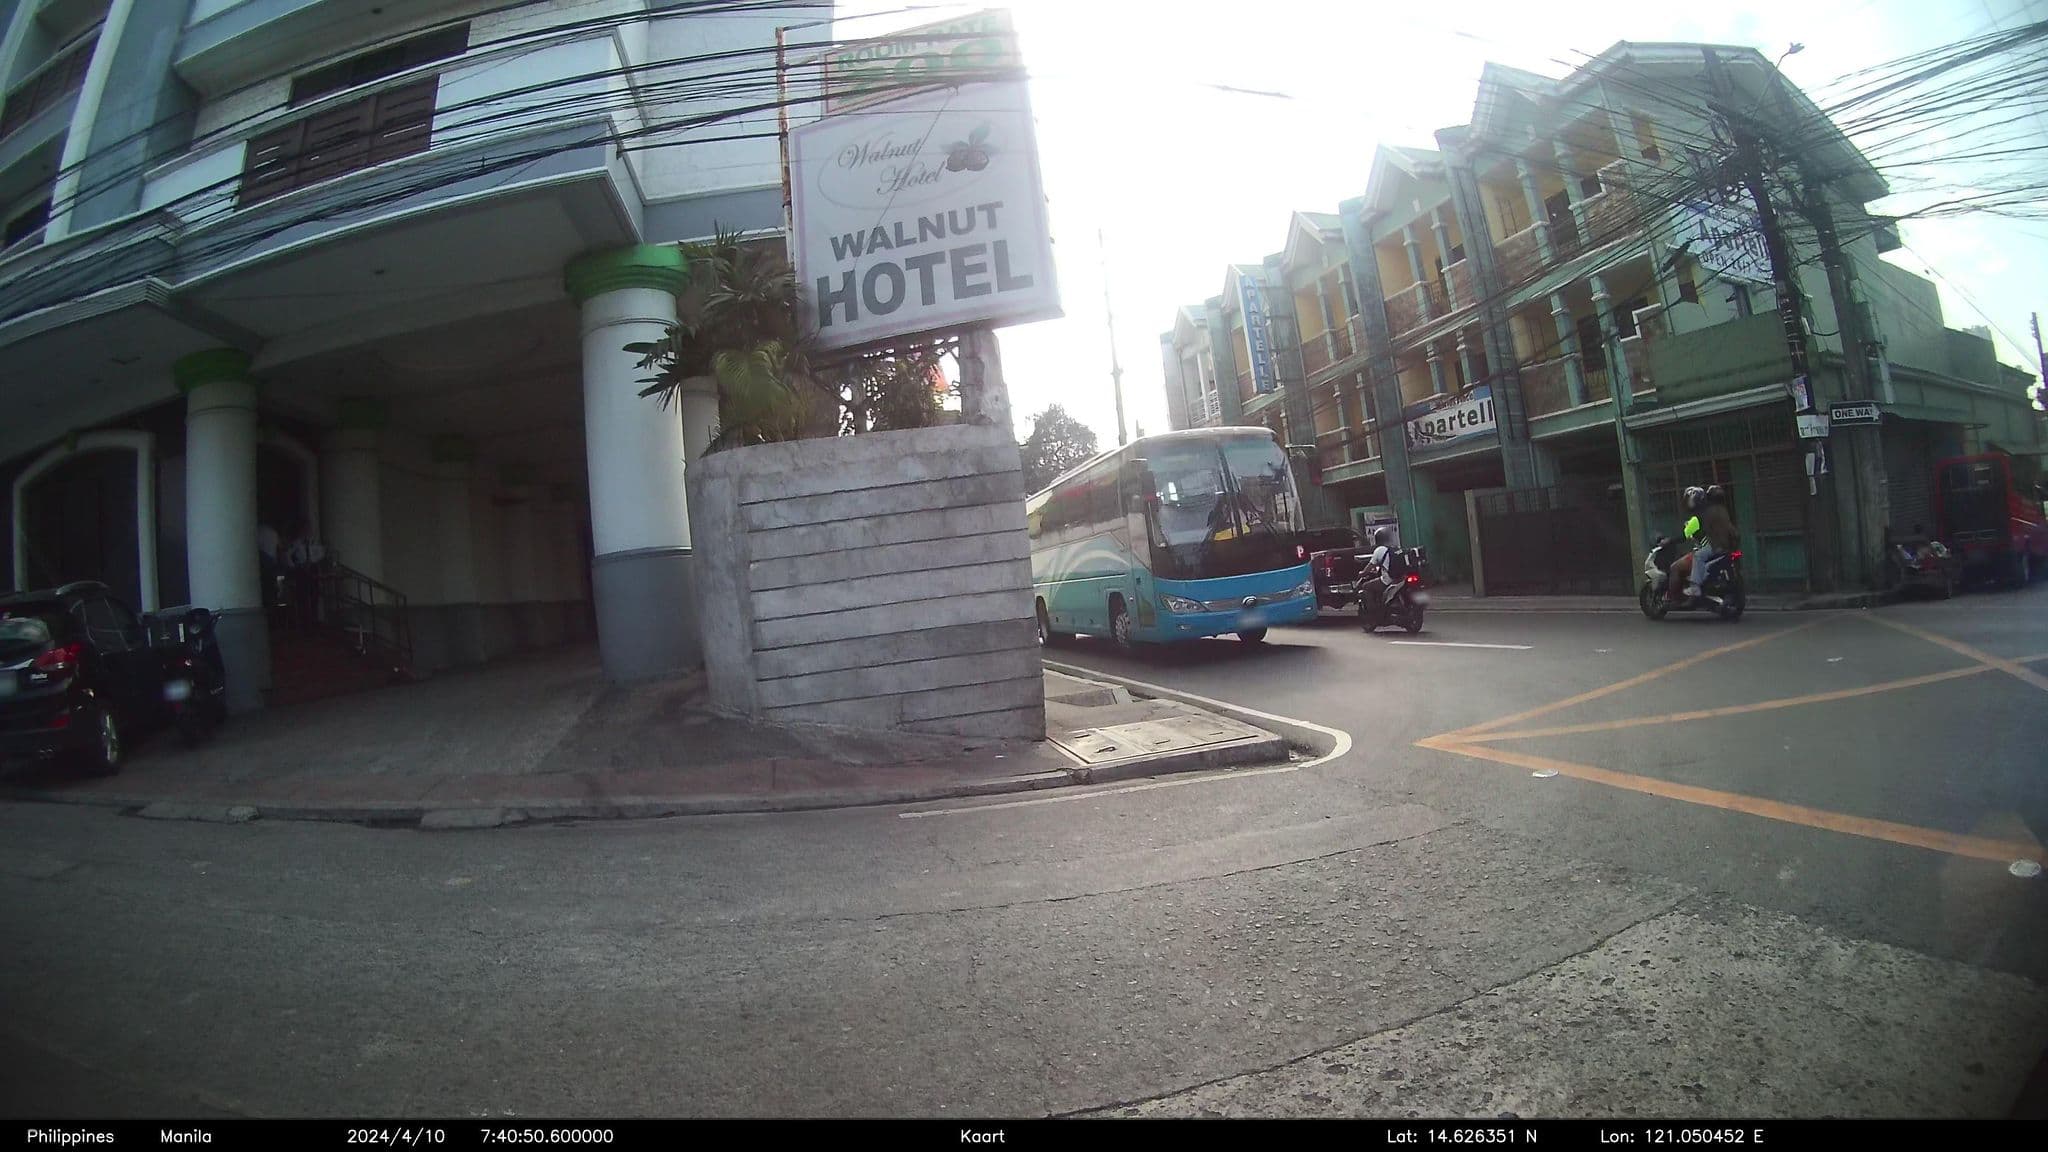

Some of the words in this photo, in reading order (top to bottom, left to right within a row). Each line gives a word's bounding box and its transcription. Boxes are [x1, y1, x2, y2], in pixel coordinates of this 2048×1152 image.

[836, 38, 918, 70] ROOM
[837, 136, 922, 169] Walnut
[876, 160, 947, 196] Hotel
[830, 200, 1004, 262] WALNUT
[816, 239, 1035, 328] HOTEL
[1243, 276, 1271, 391] APARTELLE
[1413, 400, 1495, 440] Apartell
[1834, 409, 1855, 419] ONE
